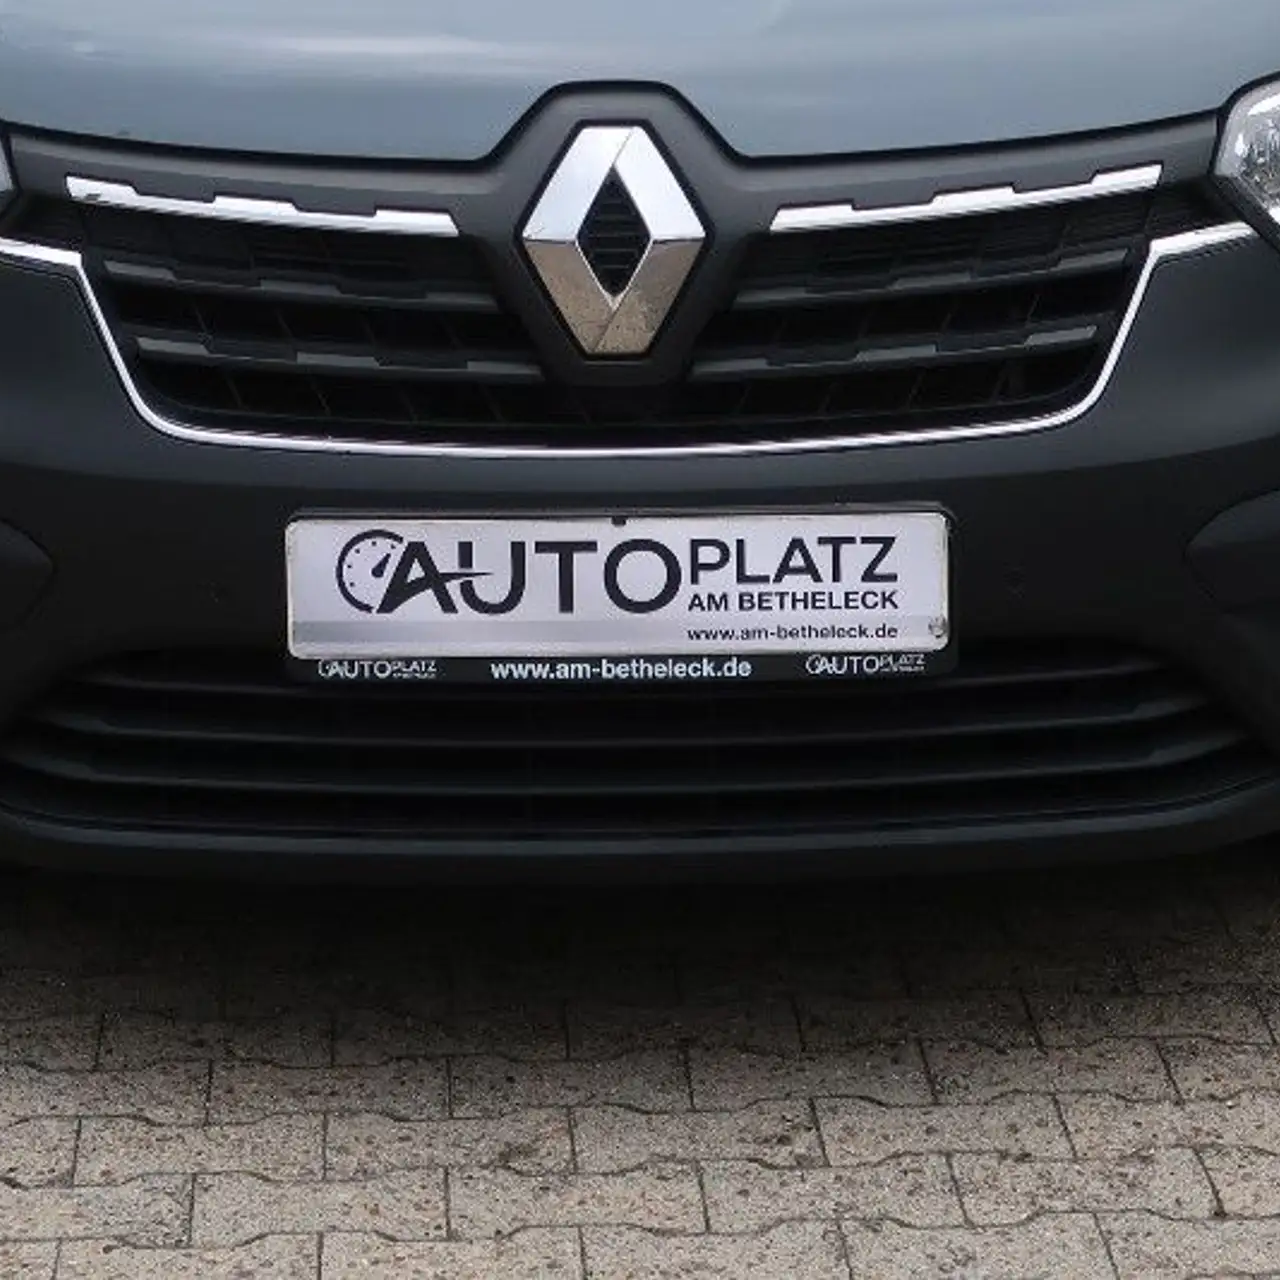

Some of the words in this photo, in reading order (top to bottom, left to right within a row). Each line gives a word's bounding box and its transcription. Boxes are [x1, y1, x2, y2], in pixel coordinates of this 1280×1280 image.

[687, 592, 729, 612] AM
[737, 590, 899, 611] BETHELECK
[686, 622, 900, 641] www.am-betheleck.de
[490, 656, 754, 680] www.am-betheleck.de
